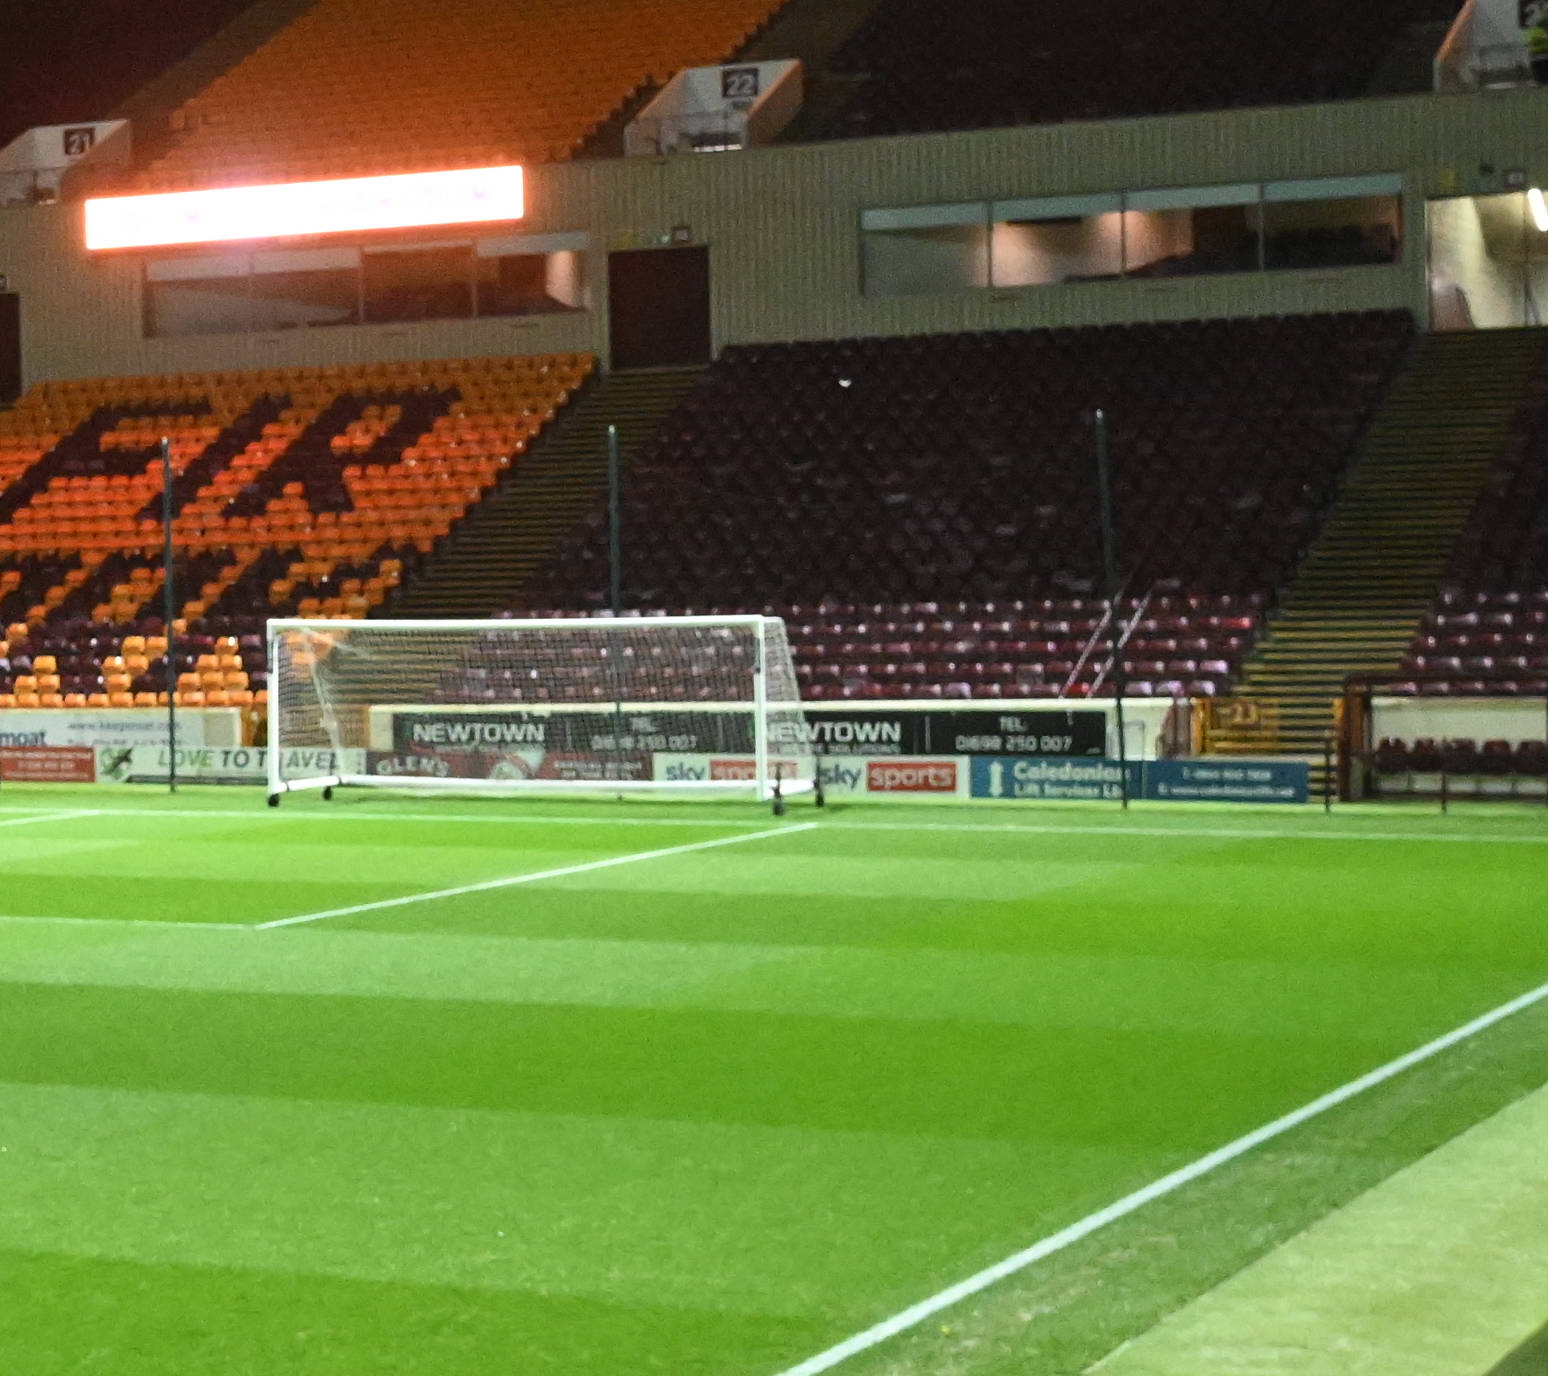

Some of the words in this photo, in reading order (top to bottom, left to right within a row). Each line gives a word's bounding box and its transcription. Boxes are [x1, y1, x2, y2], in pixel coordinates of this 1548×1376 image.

[414, 723, 545, 743] NEWTOWN
[767, 721, 902, 743] NEWTOWN
[221, 749, 250, 769] TO
[257, 749, 339, 770] TAVEL
[870, 765, 954, 791] sports
